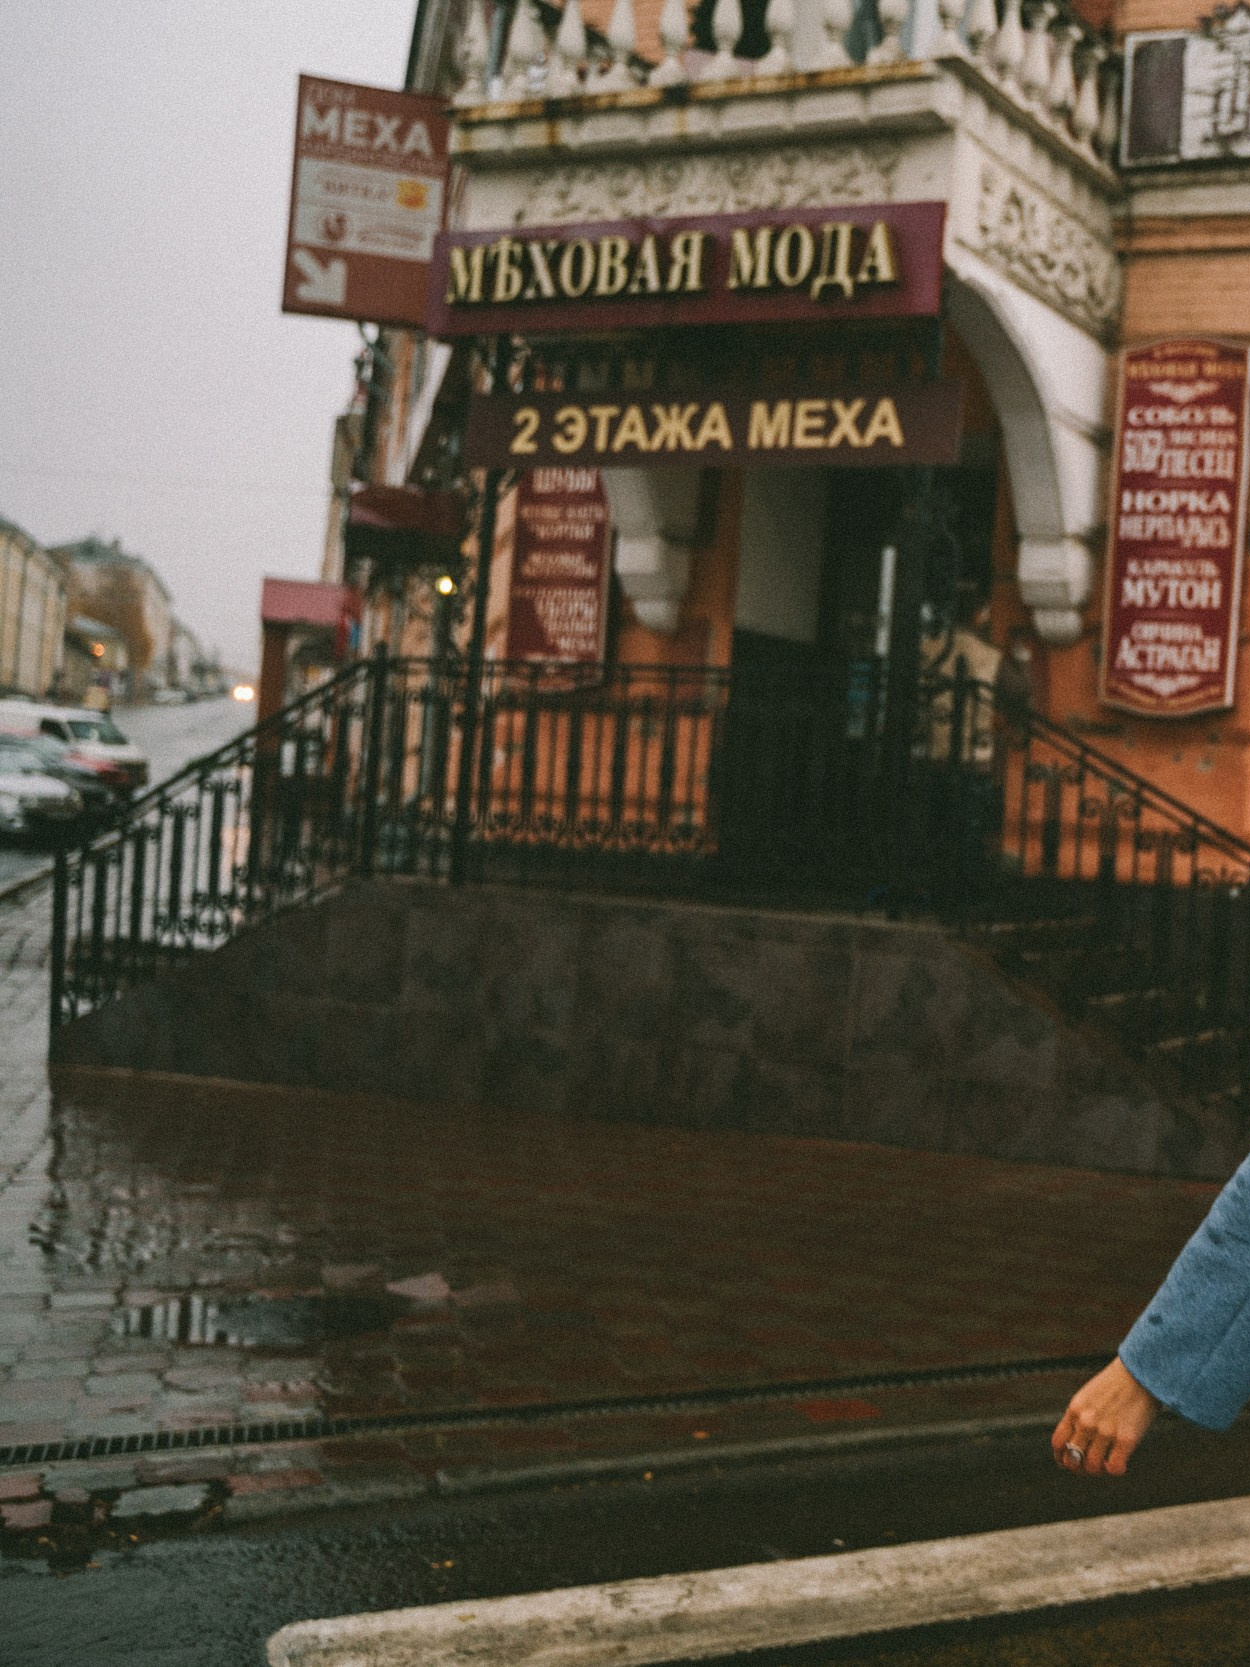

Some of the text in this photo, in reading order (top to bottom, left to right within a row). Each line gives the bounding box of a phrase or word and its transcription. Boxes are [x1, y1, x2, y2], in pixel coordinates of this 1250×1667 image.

[302, 103, 432, 157] МЕХА
[726, 219, 897, 300] МОДА
[510, 397, 905, 454] 2 ЭТАЖА МЕХА
[1120, 490, 1232, 514] НОРКА
[1121, 578, 1222, 610] МУТОН
